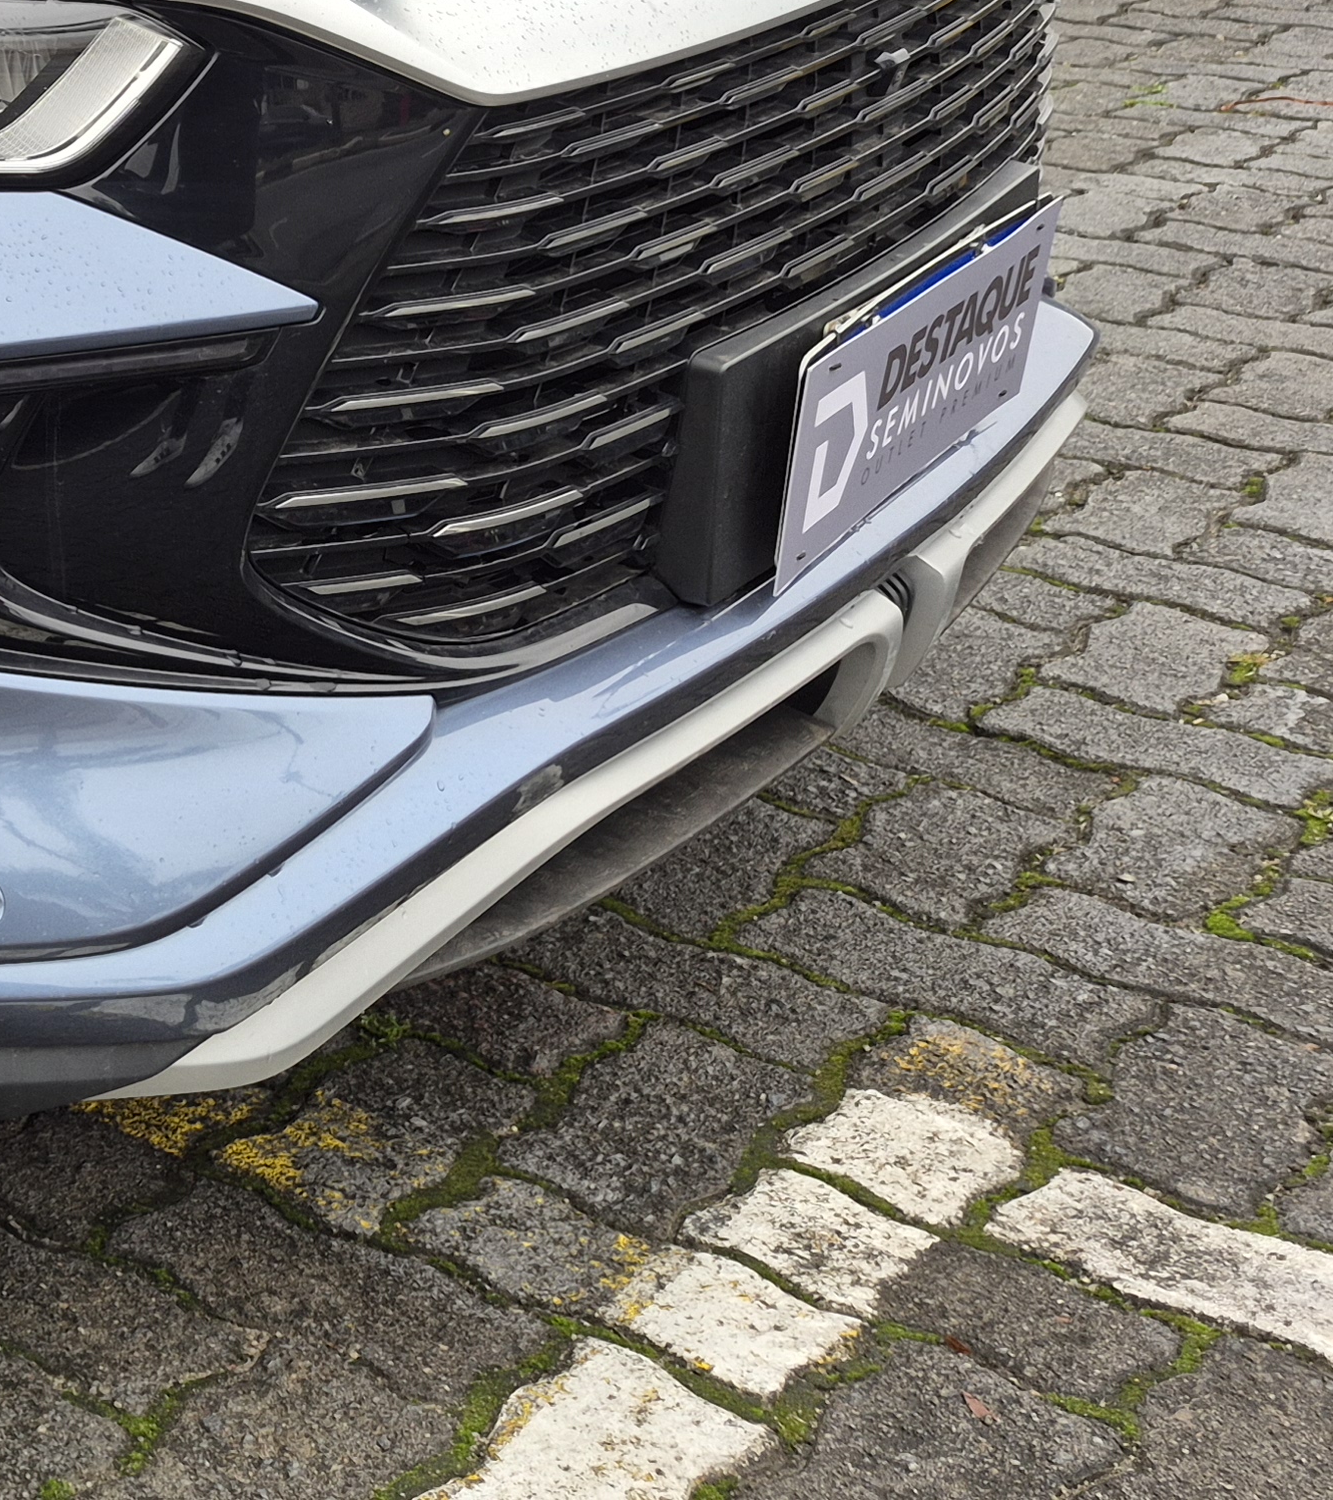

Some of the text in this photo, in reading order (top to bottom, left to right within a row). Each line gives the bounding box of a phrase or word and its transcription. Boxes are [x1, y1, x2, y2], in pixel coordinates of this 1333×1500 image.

[865, 310, 1025, 462] SEMINOVOS
[877, 244, 1041, 411] DESTAQUE
[860, 354, 1017, 486] OUTLET PREMIUM
